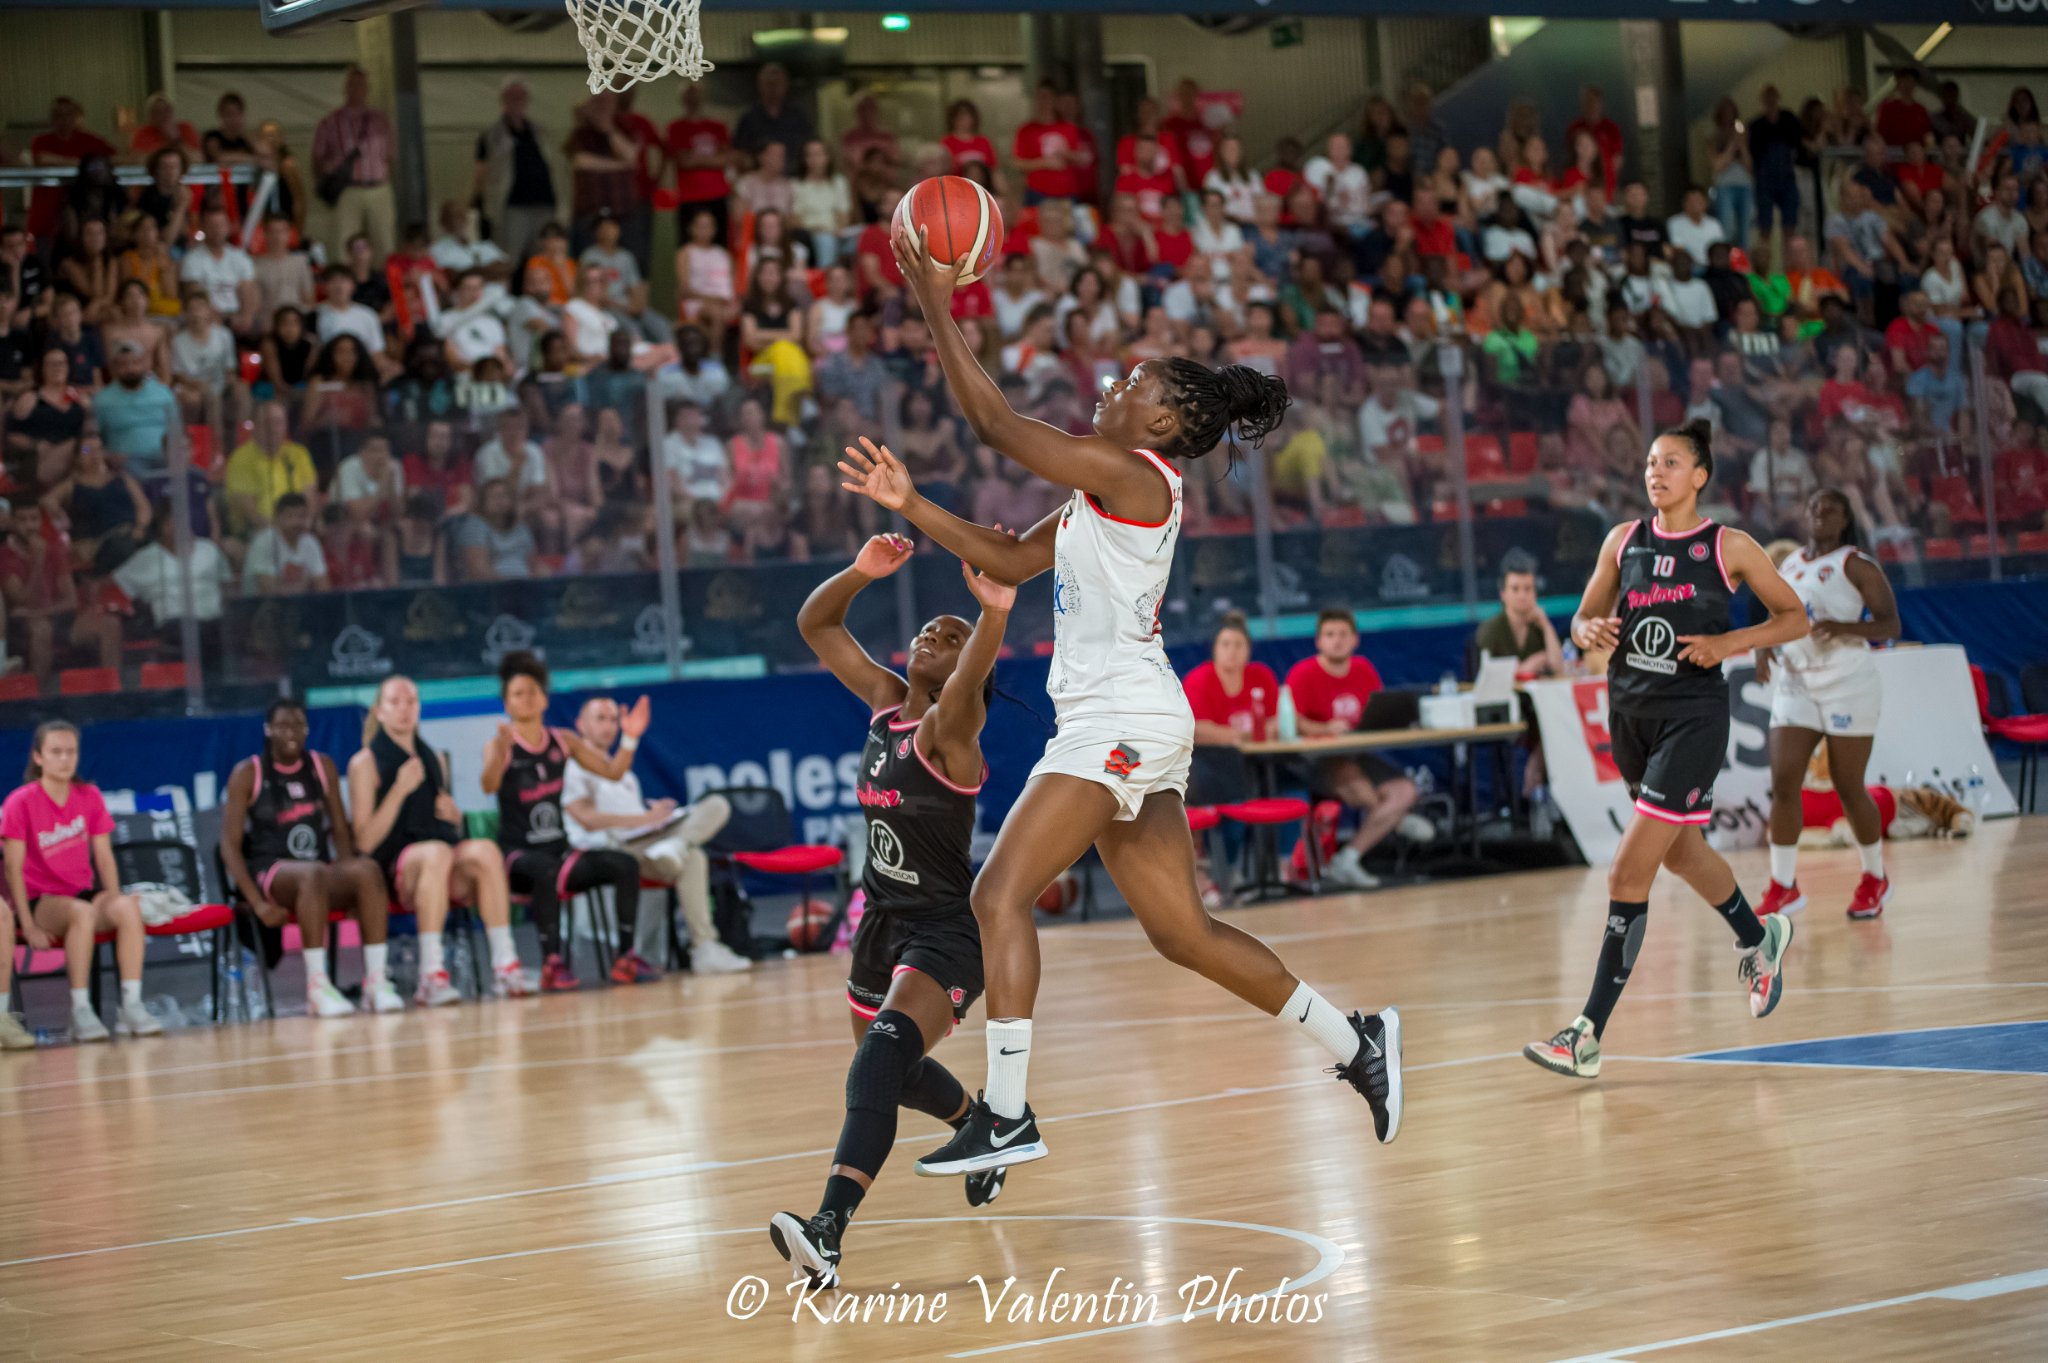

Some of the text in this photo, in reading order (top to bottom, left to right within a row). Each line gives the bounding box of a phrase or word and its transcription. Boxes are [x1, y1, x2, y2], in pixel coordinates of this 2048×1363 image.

[1653, 554, 1675, 577] 10
[1627, 582, 1697, 612] Toulouse
[1628, 656, 1675, 673] PROMOTION
[870, 751, 887, 777] 3
[873, 860, 917, 883] PROMOTION
